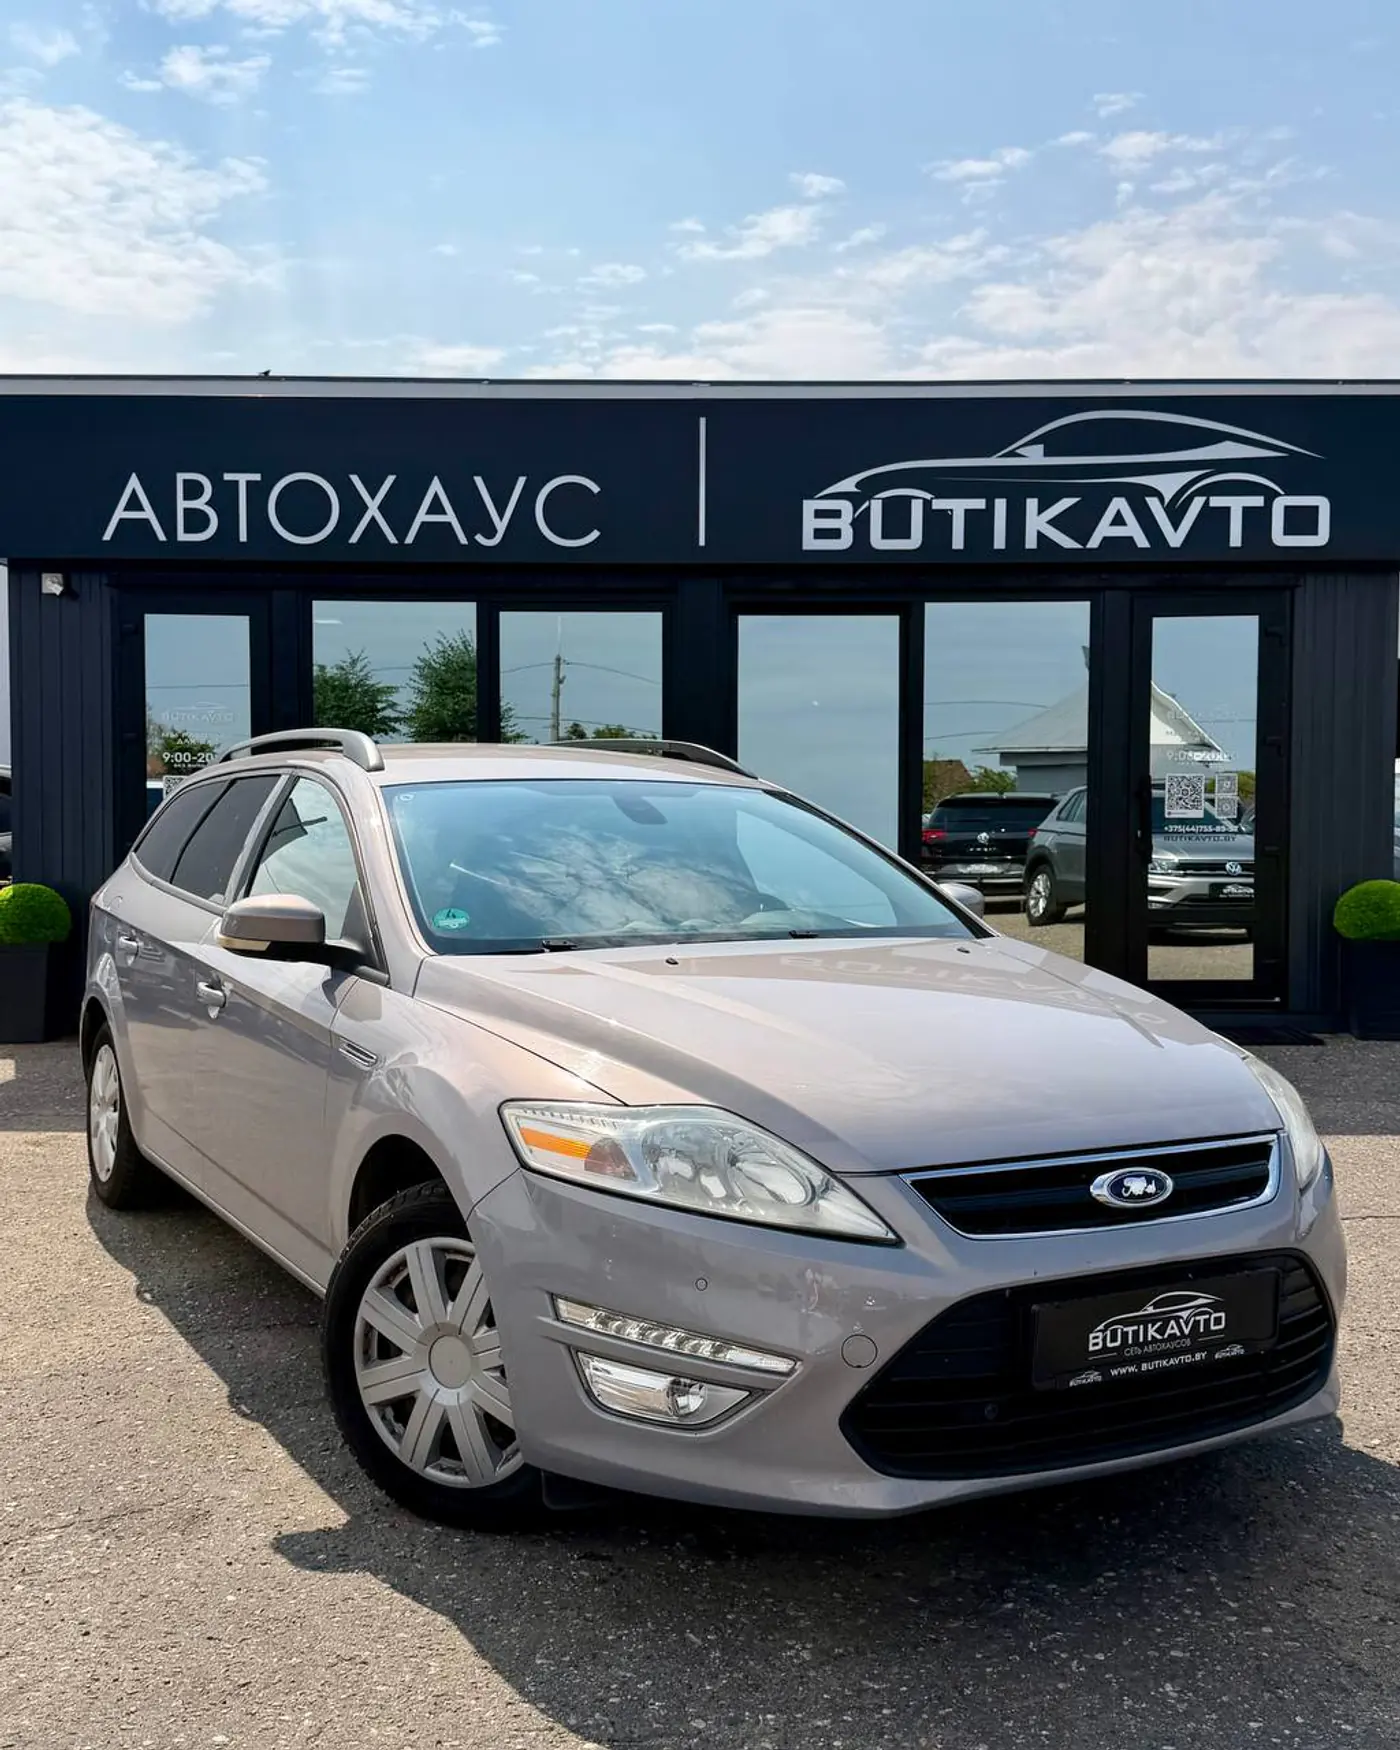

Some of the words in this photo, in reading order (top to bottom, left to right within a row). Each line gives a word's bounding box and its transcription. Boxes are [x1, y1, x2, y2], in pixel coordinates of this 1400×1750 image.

[102, 472, 601, 547] АВТОХАУС
[802, 495, 1331, 551] BUTIKAVTO
[1088, 1312, 1226, 1352] BUTIKAVTO
[1141, 1351, 1208, 1372] BUTIKAVTO.BY
